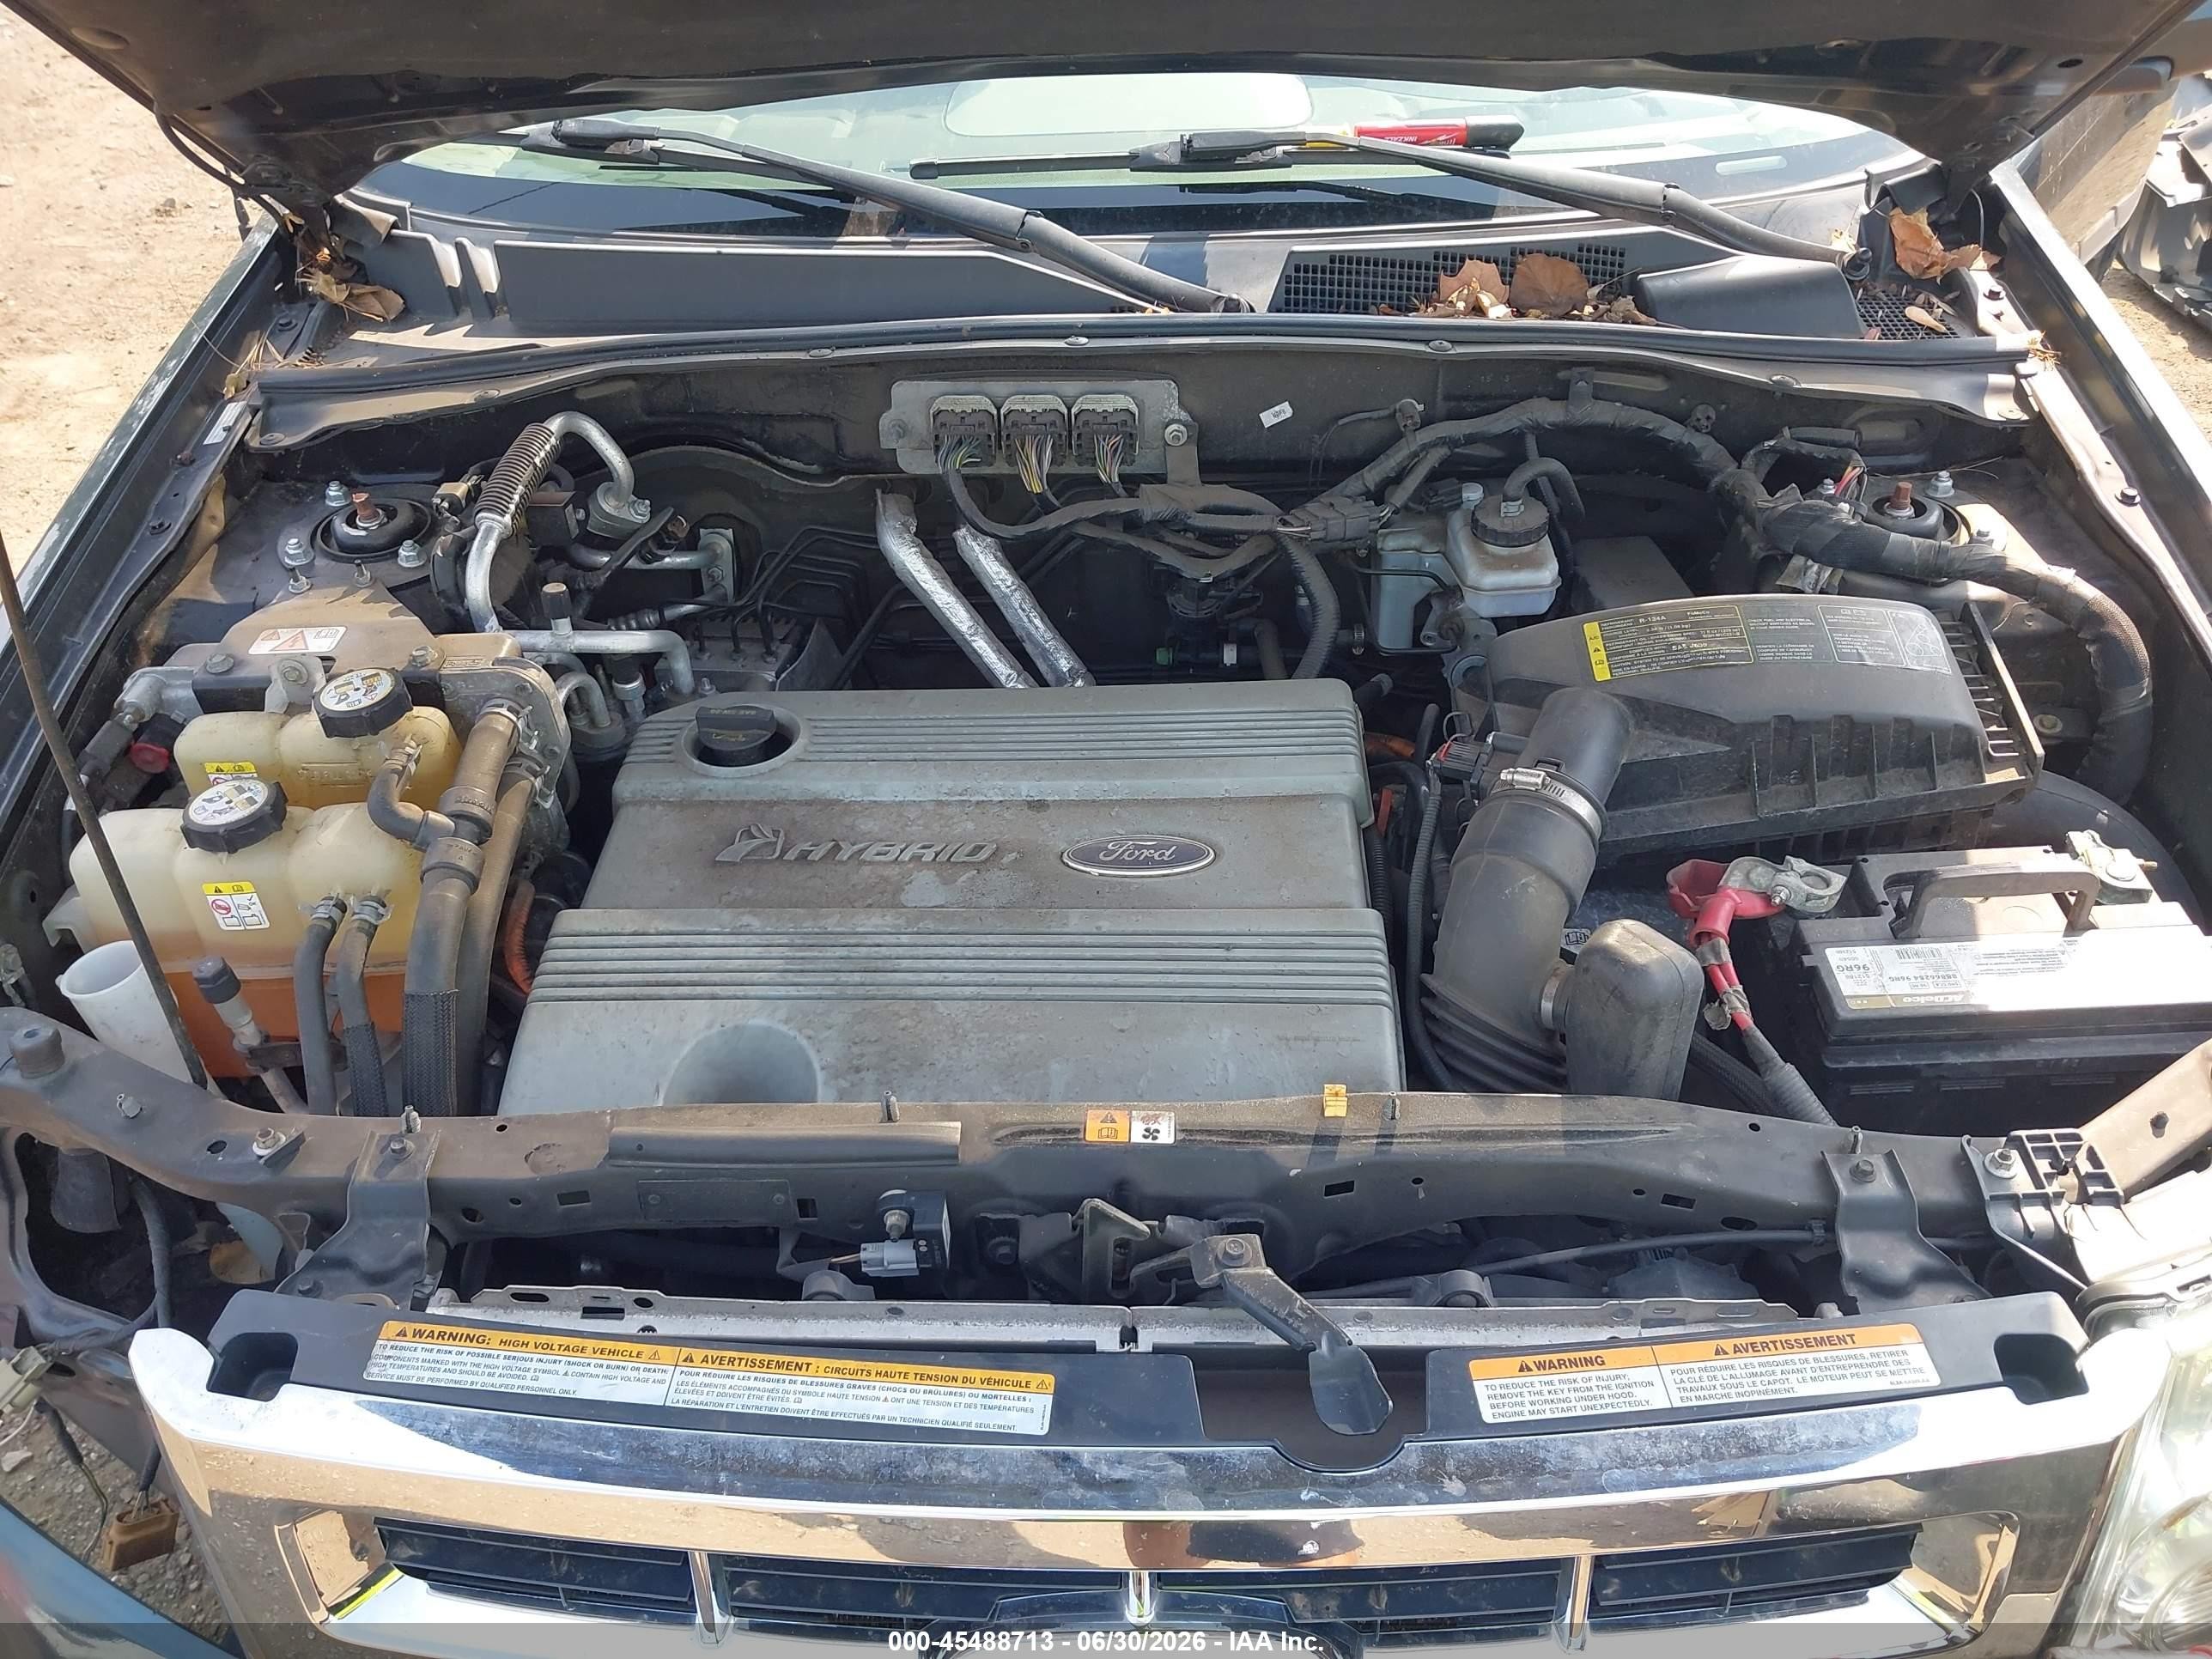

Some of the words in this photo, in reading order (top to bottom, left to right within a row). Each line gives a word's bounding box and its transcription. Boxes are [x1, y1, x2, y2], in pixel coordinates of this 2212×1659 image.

[1638, 615, 1667, 623] R-134A
[783, 842, 997, 863] HYBRID
[1099, 840, 1176, 864] Ford
[1836, 963, 1870, 972] 96RG
[1901, 994, 1966, 1005] ACDelco
[410, 1328, 492, 1345] WARNING:
[498, 1338, 530, 1348] HIGH
[532, 1341, 588, 1353] VOLTAGE
[591, 1346, 643, 1358] VEHICLE
[1729, 1333, 1858, 1354] AVERTISSEMENT
[388, 1344, 418, 1352] REDUCE
[465, 1351, 501, 1359] POSSIBLE
[501, 1354, 534, 1363] SERIOUS
[563, 1359, 592, 1368] (SHOCK
[1533, 1354, 1606, 1371] WARNING
[1669, 1367, 1696, 1376] POUR
[1756, 1358, 1797, 1368] RISQUES
[1869, 1349, 1908, 1358] RETIRER
[387, 1362, 441, 1373] TEMPERATURES
[457, 1368, 486, 1376] SHOULD
[420, 1357, 450, 1365] MARKED
[500, 1364, 532, 1373] VOLTAGE
[532, 1367, 561, 1376] SYMBOL
[569, 1370, 600, 1379] CONTAIN
[618, 1375, 650, 1383] VOLTAGE
[699, 1354, 812, 1372] AVERTISSEMENT
[823, 1365, 872, 1376] CIRCUITS
[874, 1369, 909, 1380] HAUTE
[912, 1372, 958, 1383] TENSION
[961, 1376, 976, 1384] DU
[979, 1376, 1031, 1389] VÉHICULE
[1720, 1369, 1778, 1381] L'ALLUMAGE
[1808, 1360, 1890, 1373] D'ENTREPRENDRE
[425, 1376, 469, 1386] PERFORMED
[478, 1381, 516, 1390] QUALIFIED
[515, 1384, 557, 1394] PERSONNEL
[799, 1379, 844, 1389] BLESSURES
[981, 1393, 1026, 1401] MORTELLES
[1486, 1390, 1525, 1401] REMOVE
[1566, 1385, 1594, 1394] FROM
[1614, 1380, 1655, 1389] IGNITION
[1498, 1381, 1536, 1390] REDUCE
[1557, 1376, 1579, 1385] RISK
[1675, 1383, 1718, 1394] TRAVAUX
[1718, 1381, 1745, 1390] SOUS
[1759, 1377, 1792, 1386] CAPOT.
[1808, 1372, 1849, 1382] MOTEUR
[1849, 1370, 1873, 1379] PEUT
[1887, 1366, 1924, 1376] METTRE
[715, 1390, 745, 1399] DOIVENT
[1489, 1400, 1526, 1409] BEFORE
[1528, 1396, 1572, 1407] WORKING
[1573, 1393, 1606, 1402] UNDER
[1607, 1390, 1637, 1400] HOOD.
[1693, 1391, 1734, 1401] MARCHE
[735, 1403, 779, 1413] L'ENTRETIEN
[779, 1407, 810, 1415] DOIVENT
[899, 1416, 940, 1425] TECHNICIEN
[1491, 1409, 1526, 1419] ENGINE
[1527, 1407, 1547, 1416] MAY
[1548, 1405, 1577, 1414] START
